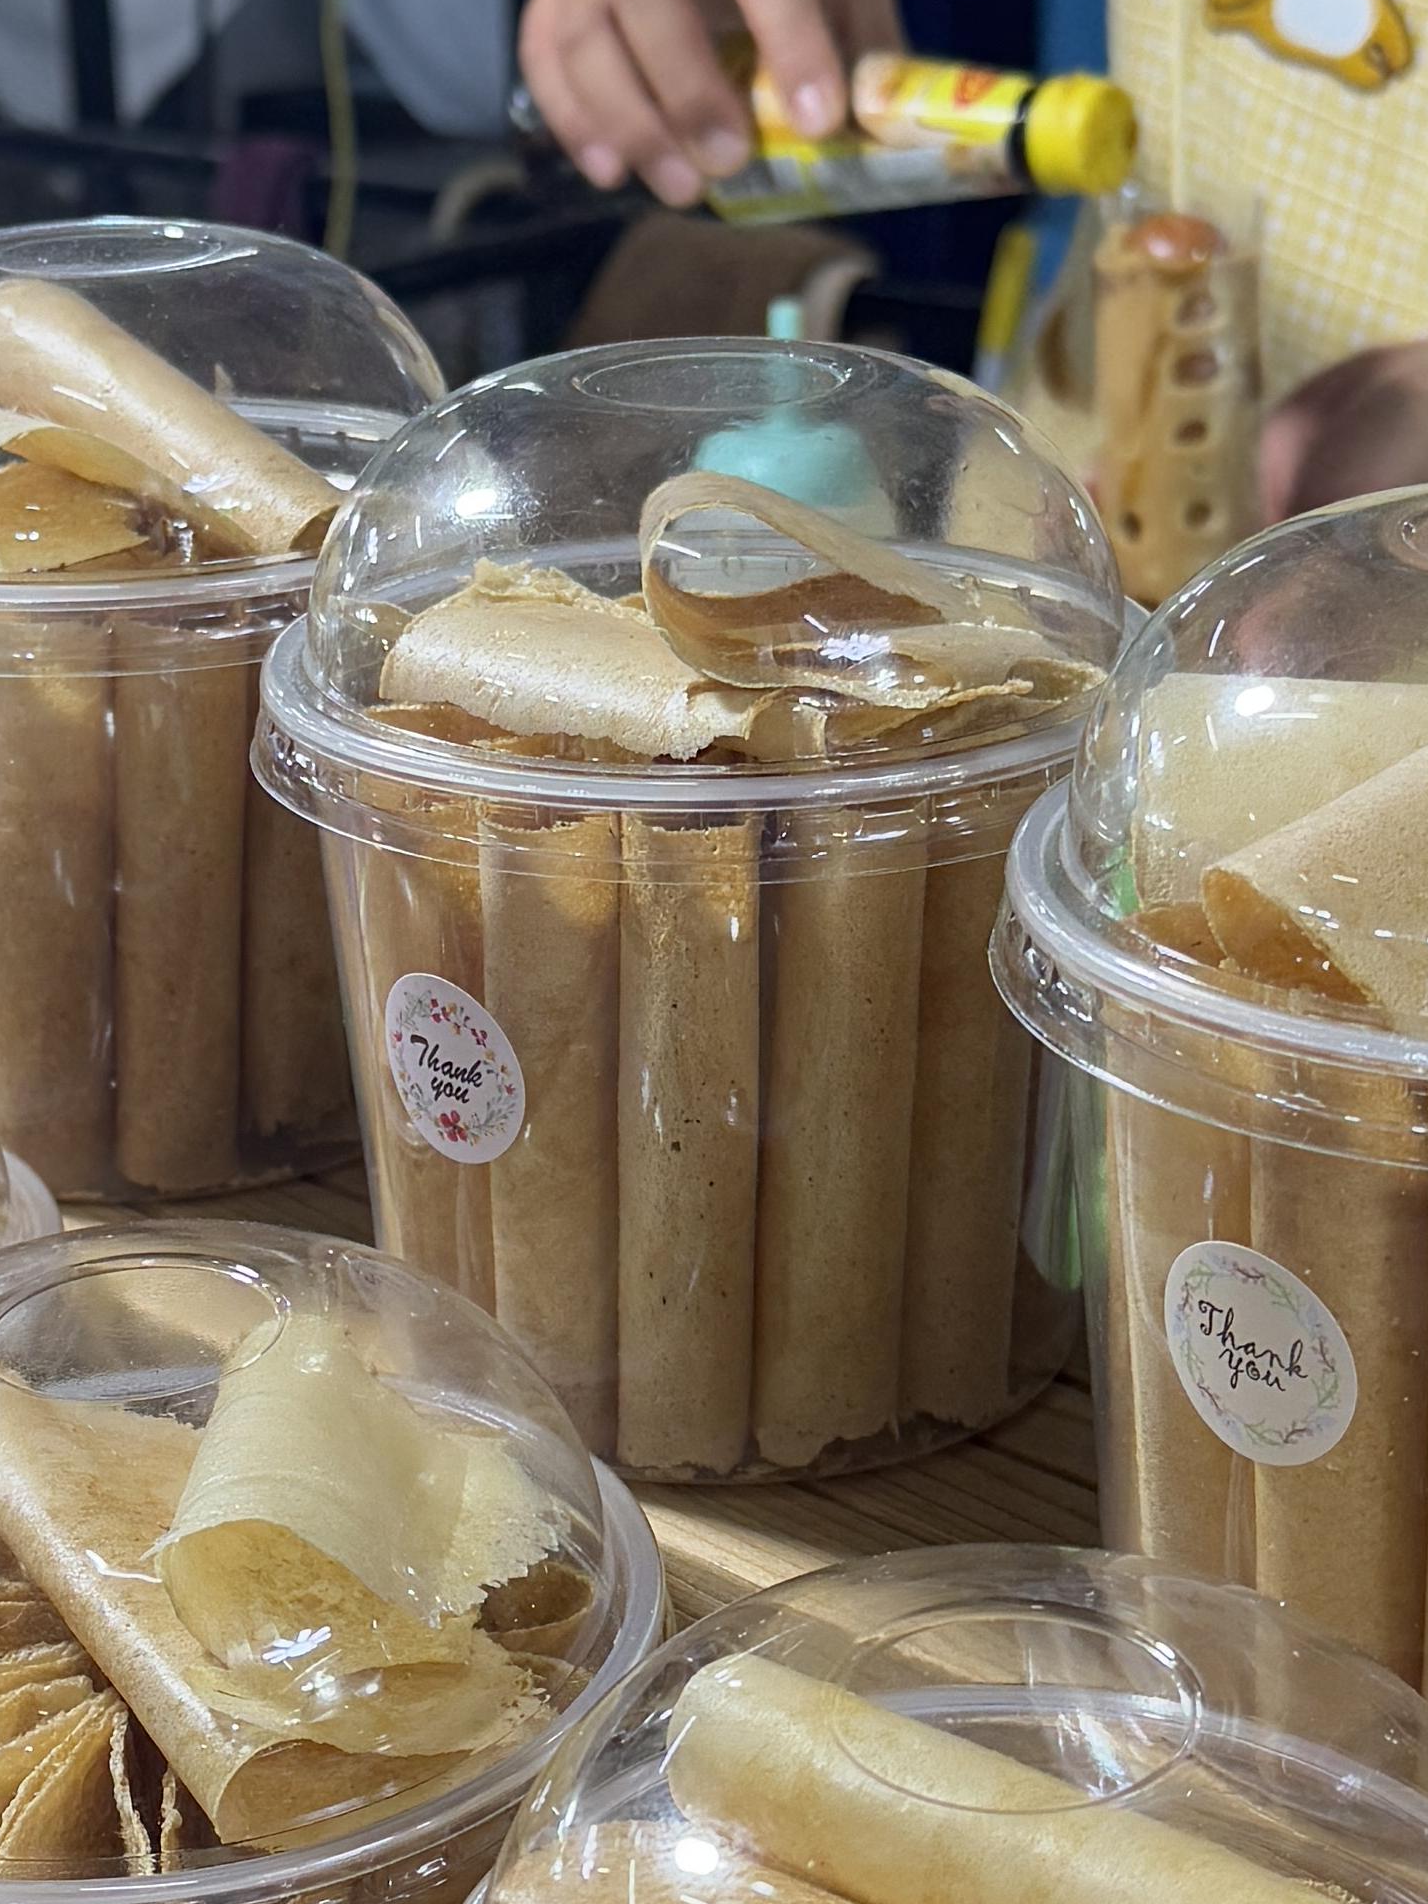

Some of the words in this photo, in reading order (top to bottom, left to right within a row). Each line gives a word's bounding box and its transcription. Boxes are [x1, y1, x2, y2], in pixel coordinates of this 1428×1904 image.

[410, 1033, 483, 1088] Thank
[430, 1076, 471, 1105] you
[1198, 1299, 1309, 1380] Thank
